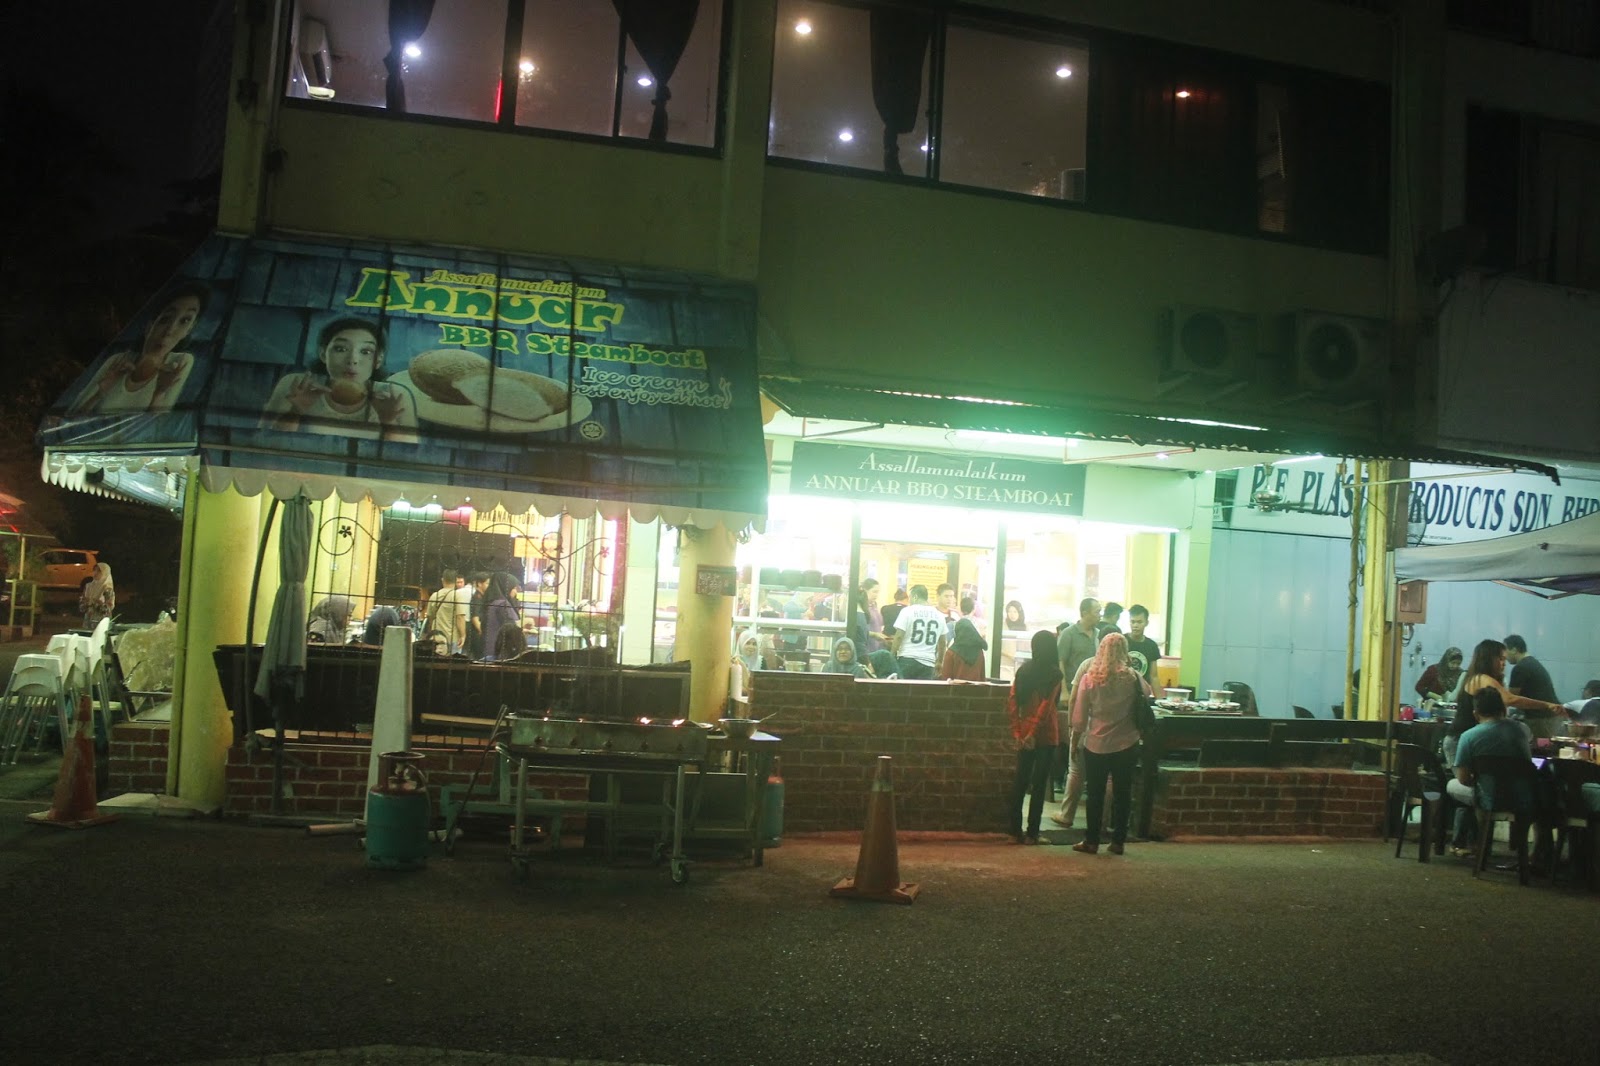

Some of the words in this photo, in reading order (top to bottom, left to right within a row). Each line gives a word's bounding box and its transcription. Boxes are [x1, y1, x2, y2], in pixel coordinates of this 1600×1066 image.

[345, 267, 625, 332] Annuar
[439, 323, 519, 355] BBQ
[527, 332, 707, 370] Steamboat
[582, 366, 625, 385] Ice
[625, 373, 709, 393] cream
[608, 387, 688, 405] enjoyed
[859, 452, 1026, 482] Assallamualaikum
[806, 475, 900, 495] ANNUAR
[907, 482, 948, 501] BBQ
[953, 485, 1073, 507] STEAMBOAT
[1408, 481, 1506, 531] RODUCTS
[911, 619, 939, 646] 66
